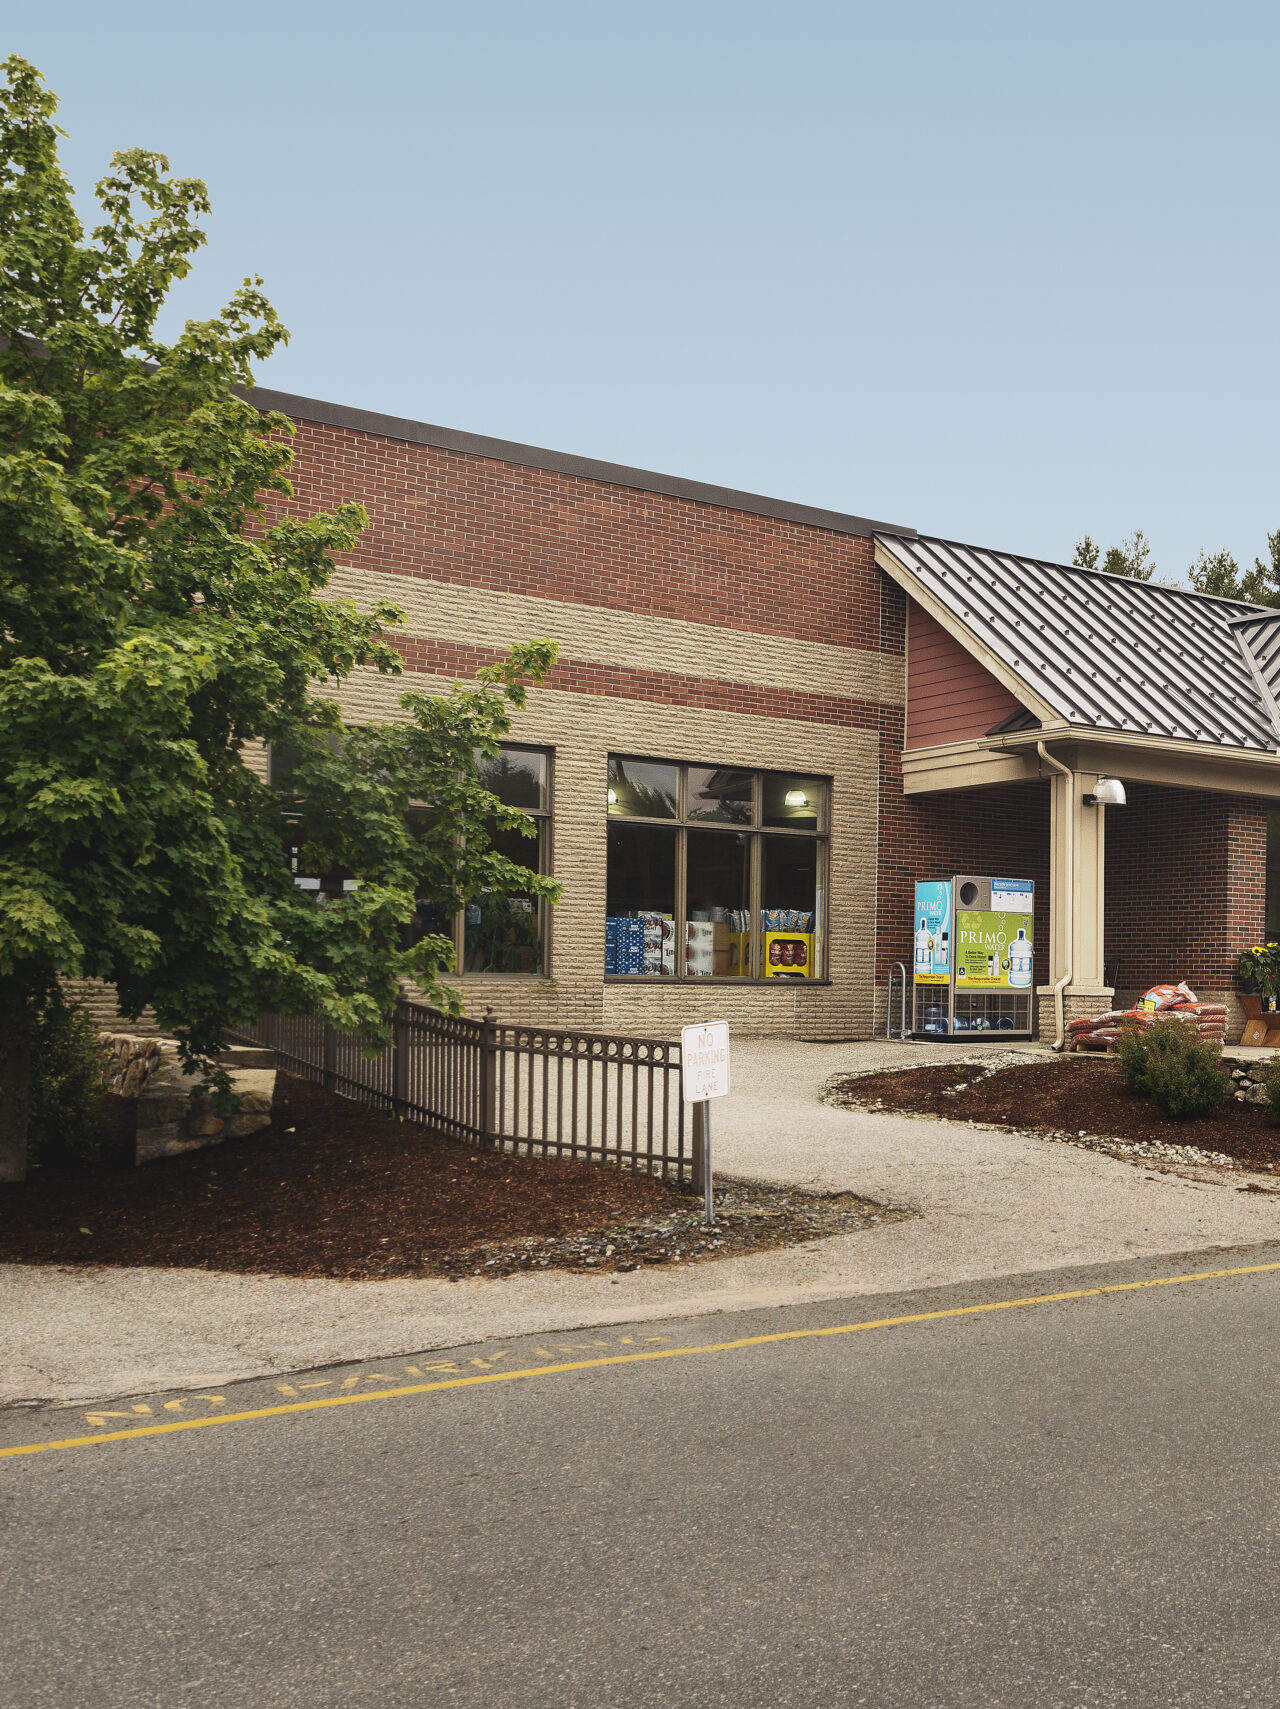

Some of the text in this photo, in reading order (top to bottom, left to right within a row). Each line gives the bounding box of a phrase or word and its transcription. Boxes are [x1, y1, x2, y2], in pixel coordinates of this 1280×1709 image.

[917, 900, 943, 911] PRIMO
[960, 930, 1007, 945] PRIMO
[697, 1033, 714, 1048] NO
[687, 1048, 726, 1067] PARKING
[697, 1069, 716, 1080] FIRE
[695, 1081, 718, 1094] LANE
[84, 1332, 672, 1427] NO PARKING
